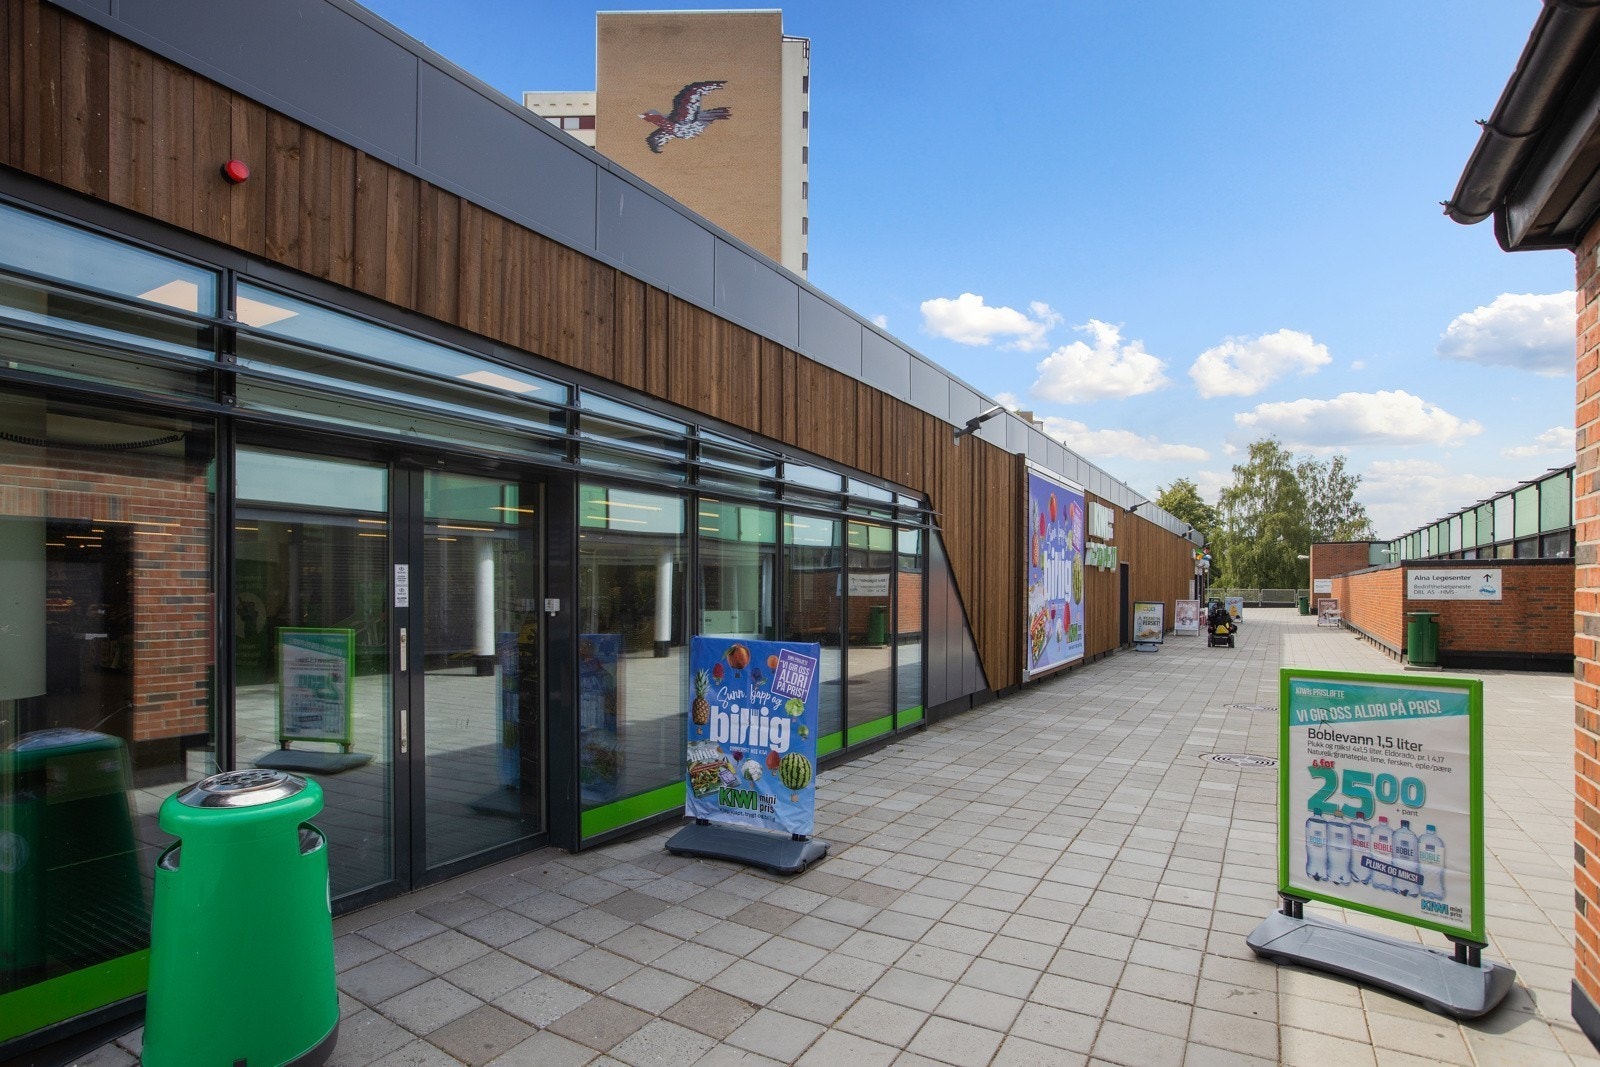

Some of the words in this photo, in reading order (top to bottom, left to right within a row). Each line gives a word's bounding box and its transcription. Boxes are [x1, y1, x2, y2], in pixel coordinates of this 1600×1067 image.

[779, 672, 808, 689] ALDRI
[1312, 688, 1344, 699] PRISLØFTE
[1296, 710, 1308, 722] VI
[1310, 708, 1328, 721] GIR
[1330, 706, 1352, 720] OSS
[1354, 703, 1388, 718] ALDRI
[1390, 698, 1406, 716] PÅ
[1408, 699, 1442, 715] PRIS!
[710, 704, 790, 753] billig
[1308, 728, 1374, 746] Boblevann
[1377, 736, 1394, 748] 1,5
[1397, 738, 1423, 752] liter
[1370, 756, 1386, 764] lime,
[1388, 758, 1414, 768] fersken,
[718, 787, 758, 810] KIWI
[760, 794, 776, 804] mini
[760, 804, 774, 814] pris
[1402, 808, 1418, 817] pant
[1352, 838, 1370, 848] BOBLE
[1374, 842, 1392, 852] BOBLE
[1396, 846, 1414, 856] BOBLE
[1420, 852, 1440, 863] BOBLE
[1366, 858, 1387, 872] PLUKK
[1388, 864, 1397, 876] OG
[1398, 868, 1418, 882] MIKS!
[1420, 898, 1449, 916] KIWI
[1450, 906, 1462, 914] mini
